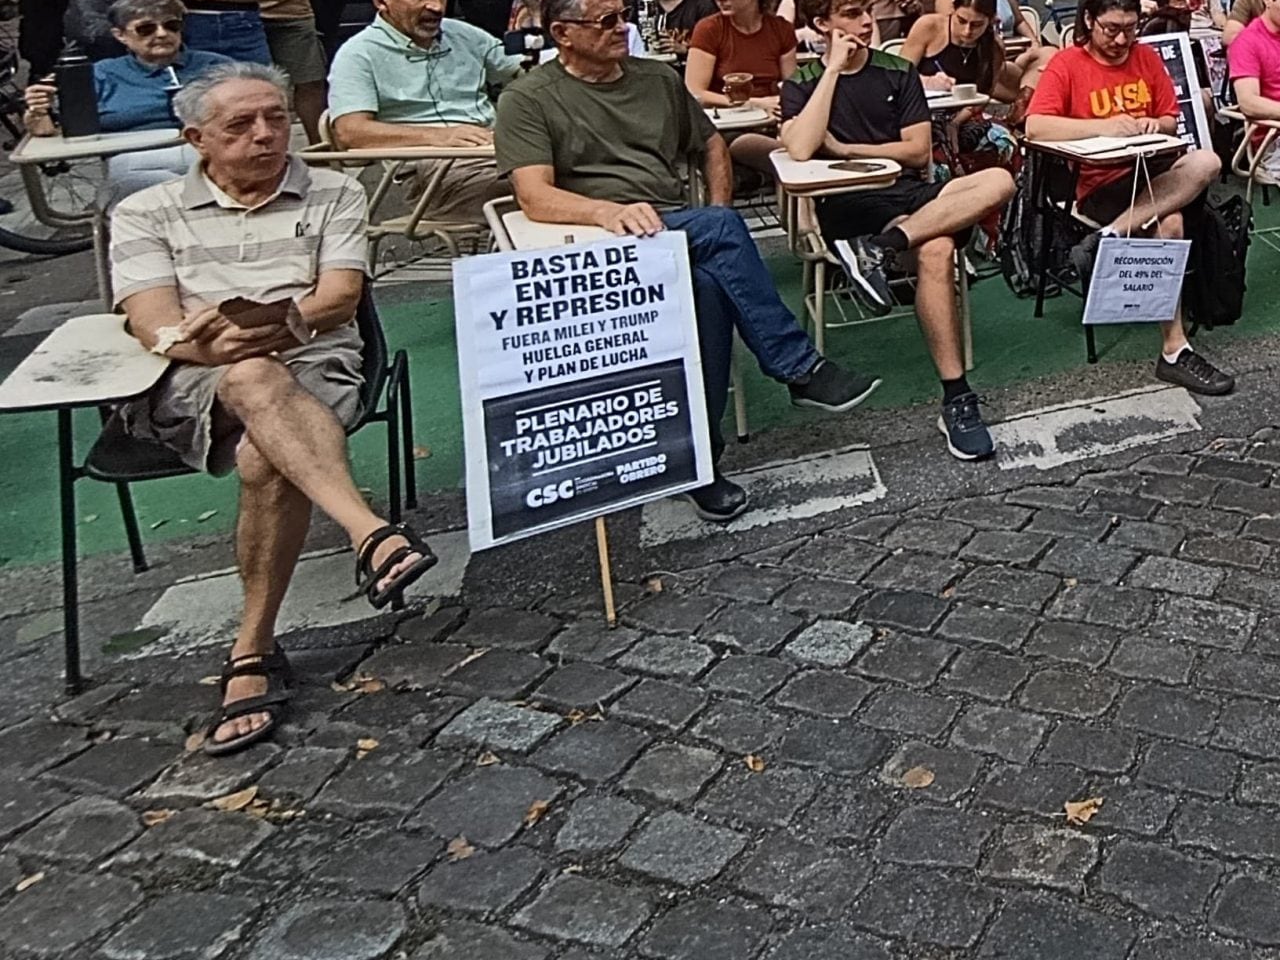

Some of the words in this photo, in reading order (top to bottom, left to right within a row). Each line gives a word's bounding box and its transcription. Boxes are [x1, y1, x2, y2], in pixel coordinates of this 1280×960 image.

[1161, 45, 1176, 60] DE
[512, 252, 599, 281] BASTA
[605, 245, 638, 265] DE
[516, 267, 640, 302] ENTREGA
[490, 310, 508, 330] Y
[502, 329, 551, 351] FUERA
[554, 323, 595, 341] MILEI
[598, 321, 607, 332] Y
[609, 310, 659, 330] TRUMP
[522, 345, 582, 365] HUELGA
[586, 330, 648, 353] GENERAL
[524, 371, 534, 383] Y
[538, 363, 577, 381] PLAN
[580, 359, 598, 373] DE
[602, 348, 648, 369] LUCHA
[516, 395, 628, 435] PLENARIO
[634, 388, 663, 405] DE
[501, 401, 679, 458] TRABAJADORES
[532, 424, 657, 469] JUBILADOS
[616, 454, 667, 476] PARTIDO
[619, 463, 666, 484] OBRERO
[526, 479, 574, 508] CSC
